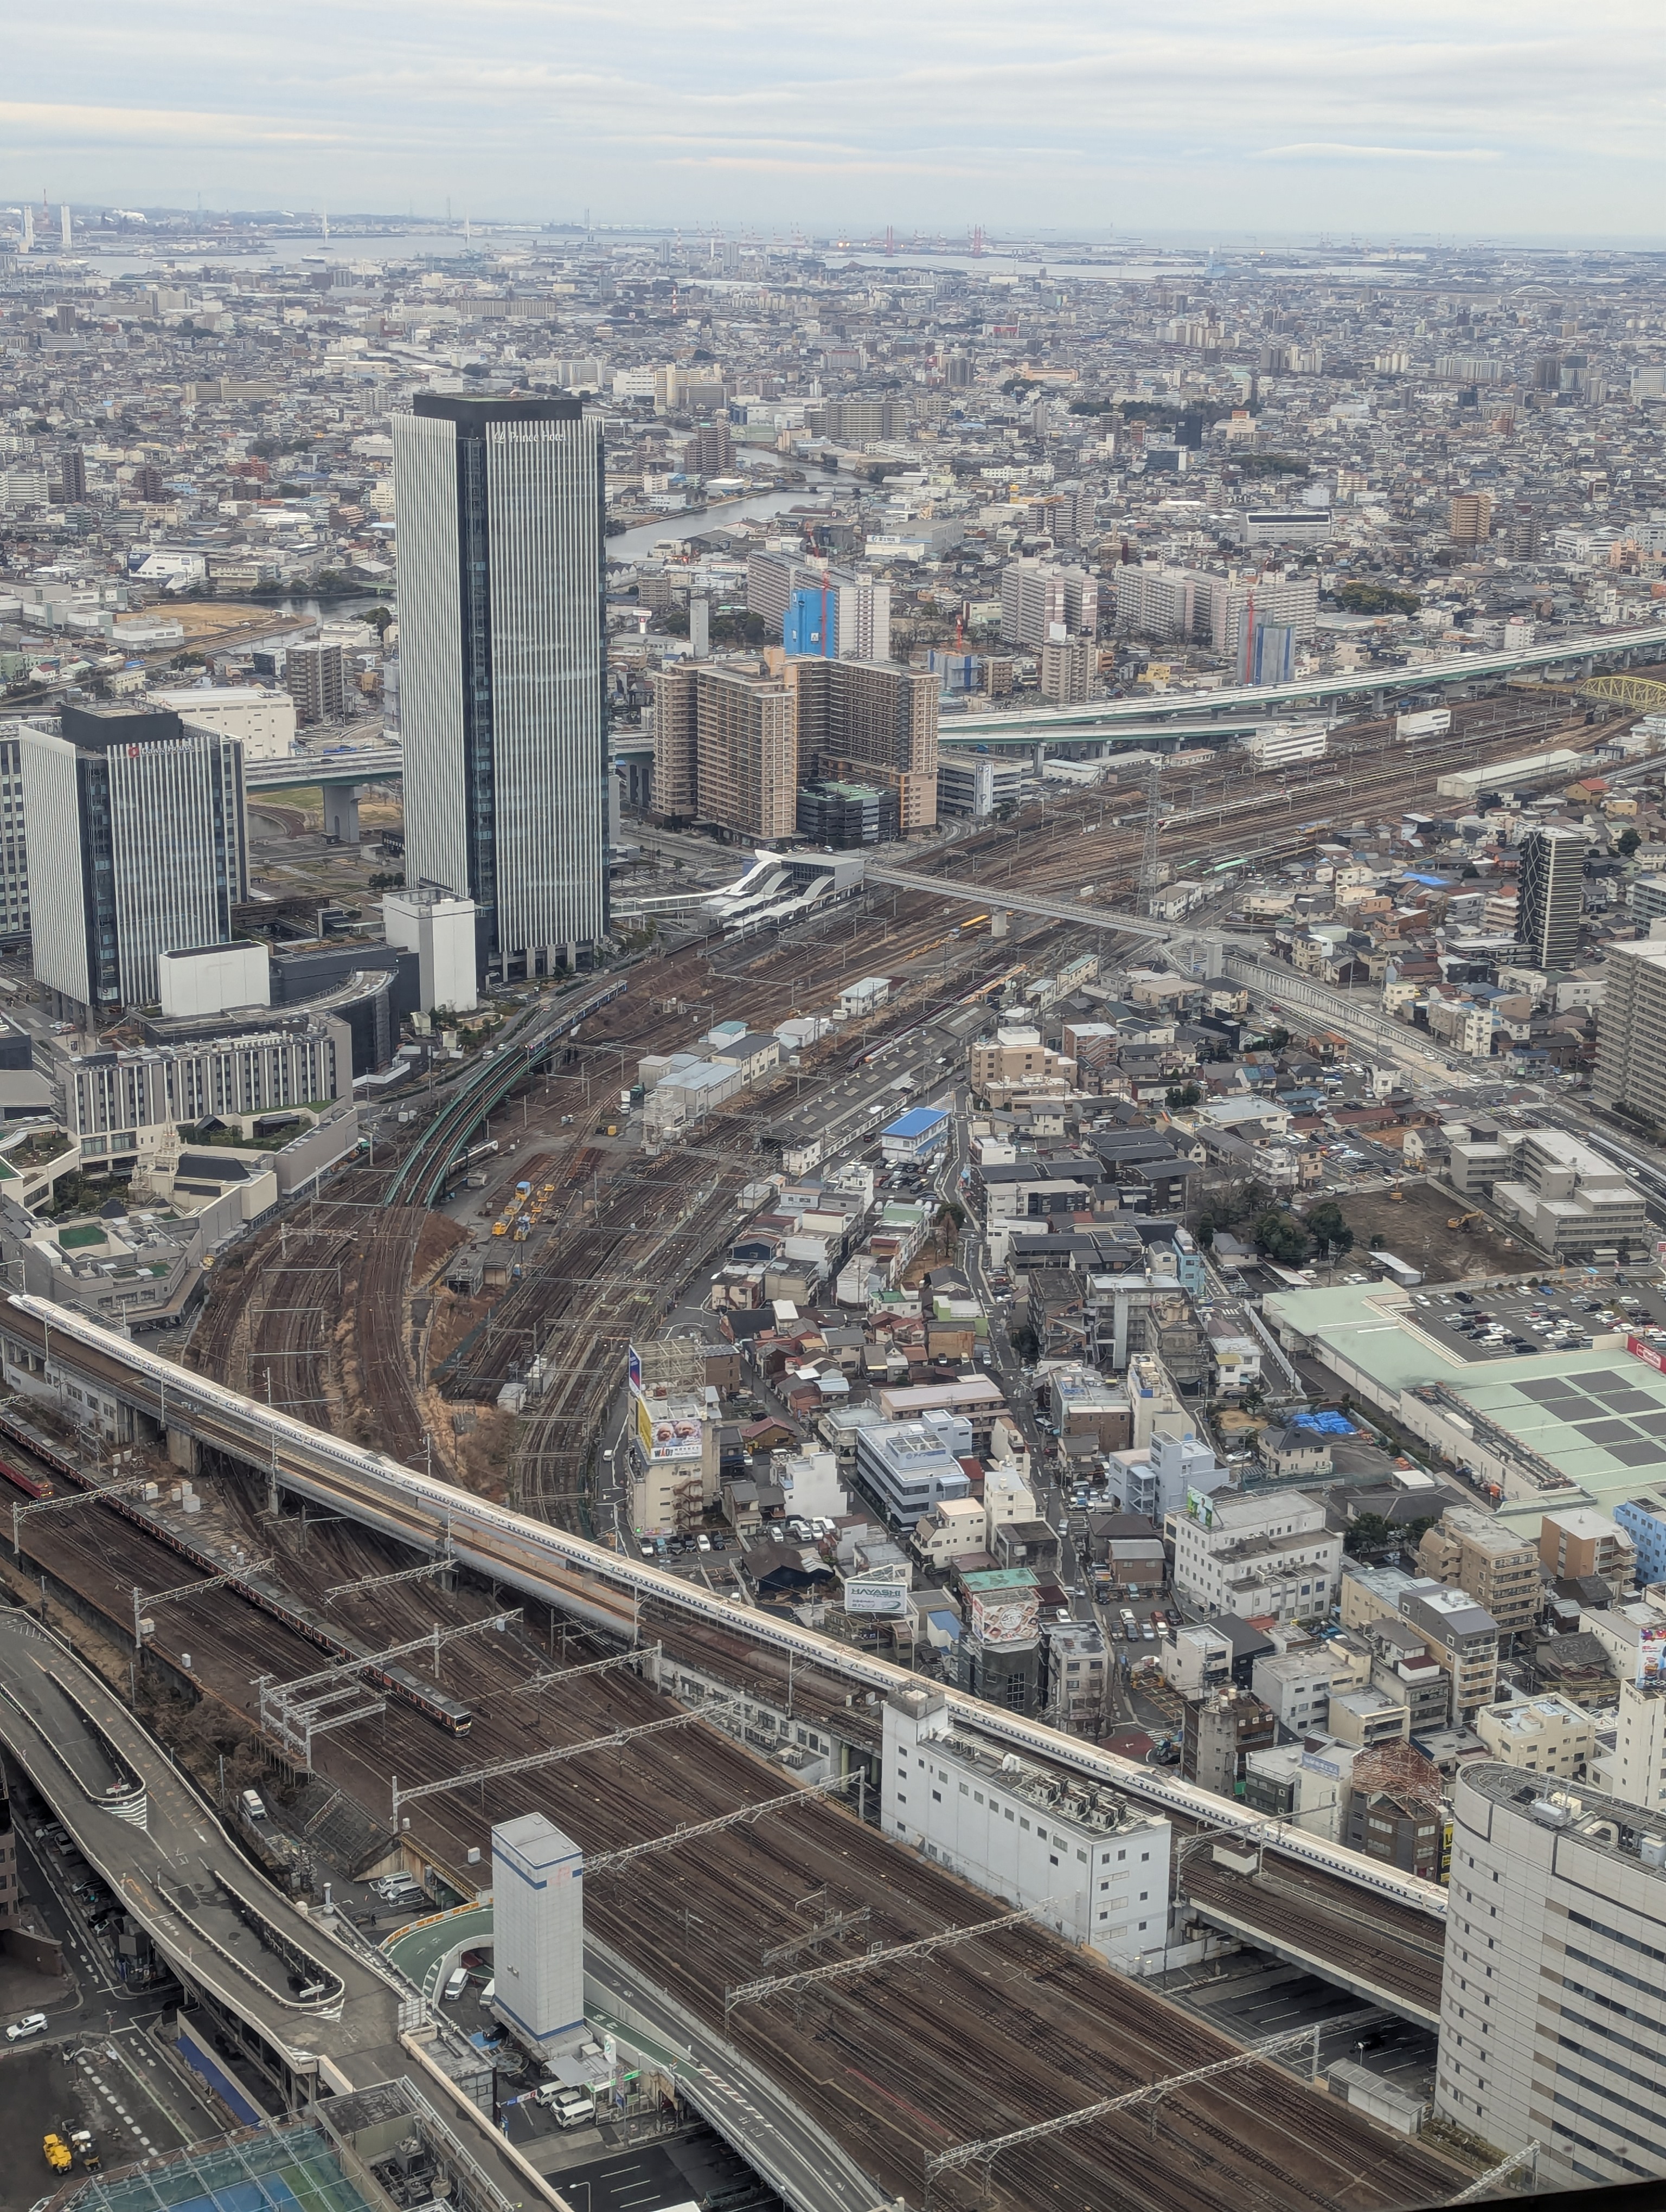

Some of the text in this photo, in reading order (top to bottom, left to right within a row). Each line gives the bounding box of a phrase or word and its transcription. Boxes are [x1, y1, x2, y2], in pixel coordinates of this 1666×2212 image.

[510, 429, 566, 443] Prince Hotel
[850, 1588, 901, 1597] HAYASHI
